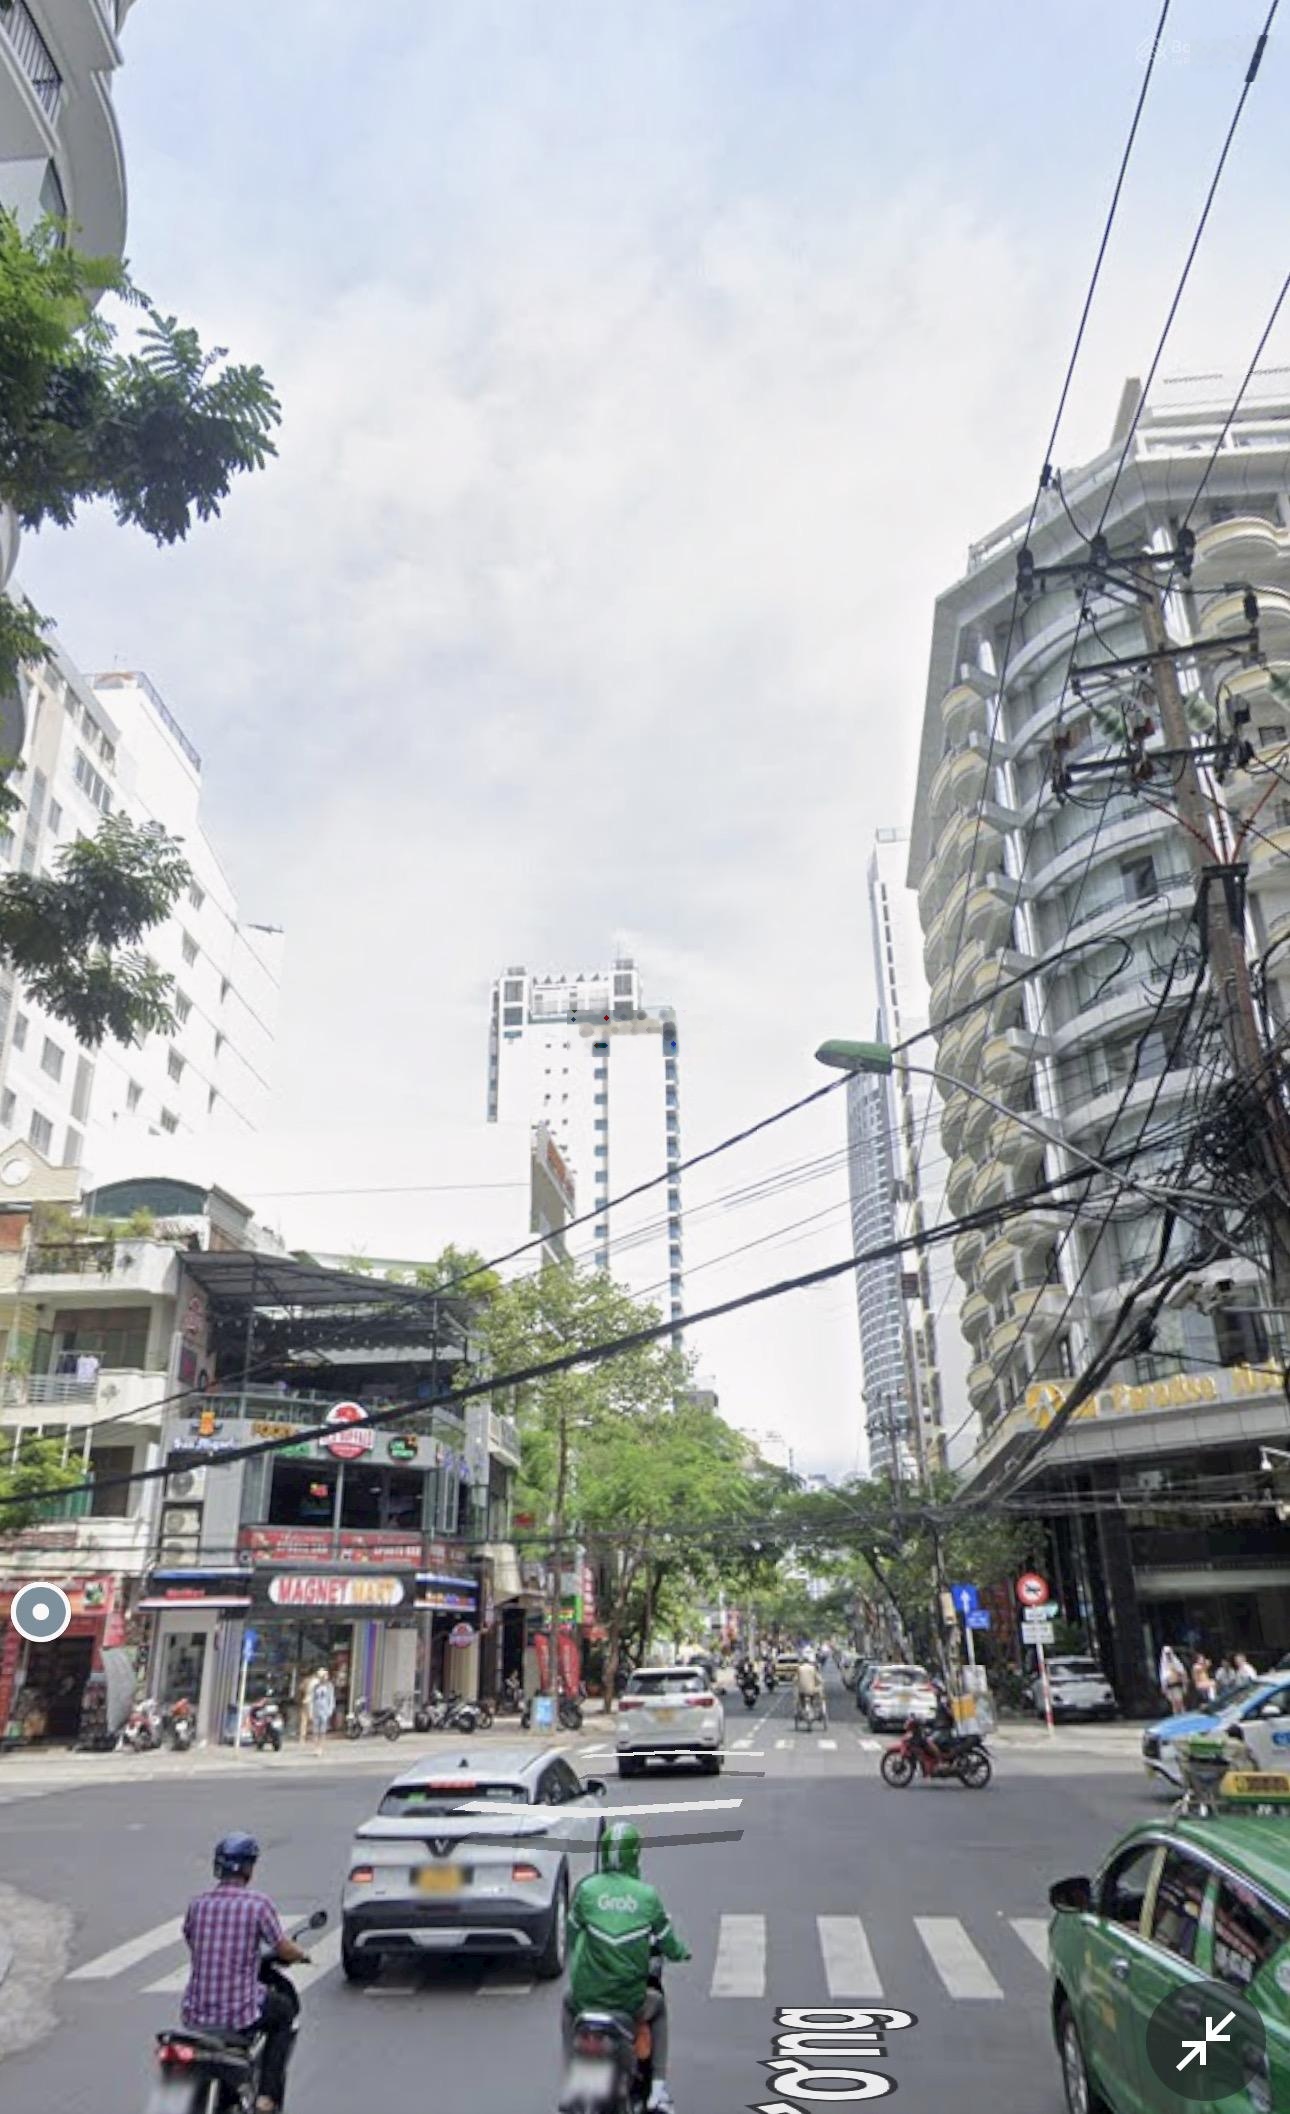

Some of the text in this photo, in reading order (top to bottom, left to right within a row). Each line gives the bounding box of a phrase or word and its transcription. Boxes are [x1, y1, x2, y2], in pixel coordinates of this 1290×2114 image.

[1112, 1372, 1217, 1413] Paradise
[278, 1577, 349, 1604] MAGNET
[352, 1576, 396, 1605] MART
[598, 1893, 638, 1914] Grab
